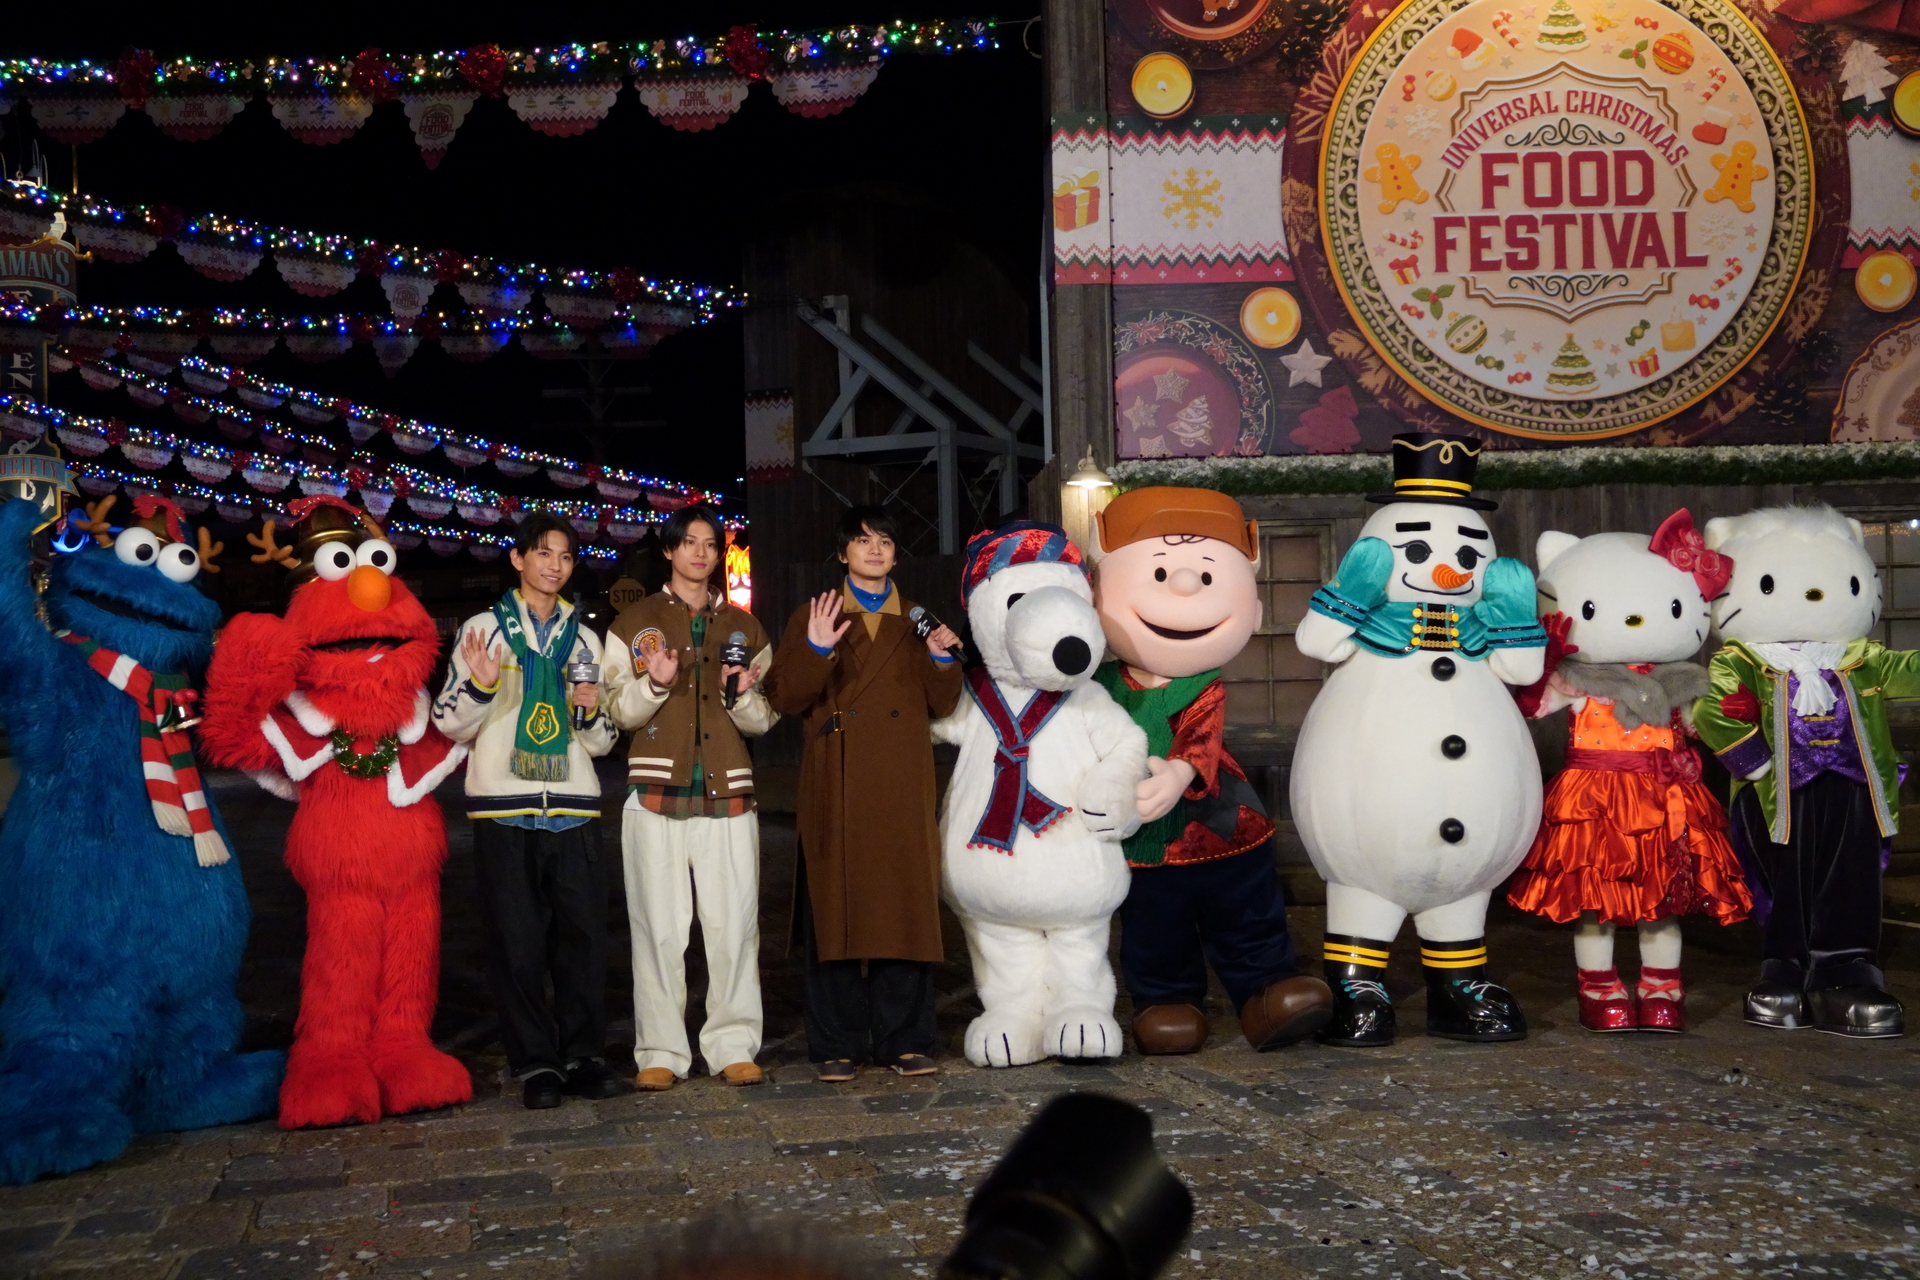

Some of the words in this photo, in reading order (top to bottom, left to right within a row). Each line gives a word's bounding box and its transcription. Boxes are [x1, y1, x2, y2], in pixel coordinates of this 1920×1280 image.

[685, 90, 706, 99] FOOD
[679, 98, 711, 107] FESTIVAL
[426, 115, 449, 125] FOOD
[418, 123, 454, 135] FESTIVAL
[1440, 89, 1560, 171] UNIVERSAL
[1566, 89, 1690, 166] CHRISTMAS
[1480, 149, 1656, 210] FOOD
[1432, 210, 1710, 273] FESTIVAL
[613, 589, 643, 603] STOP
